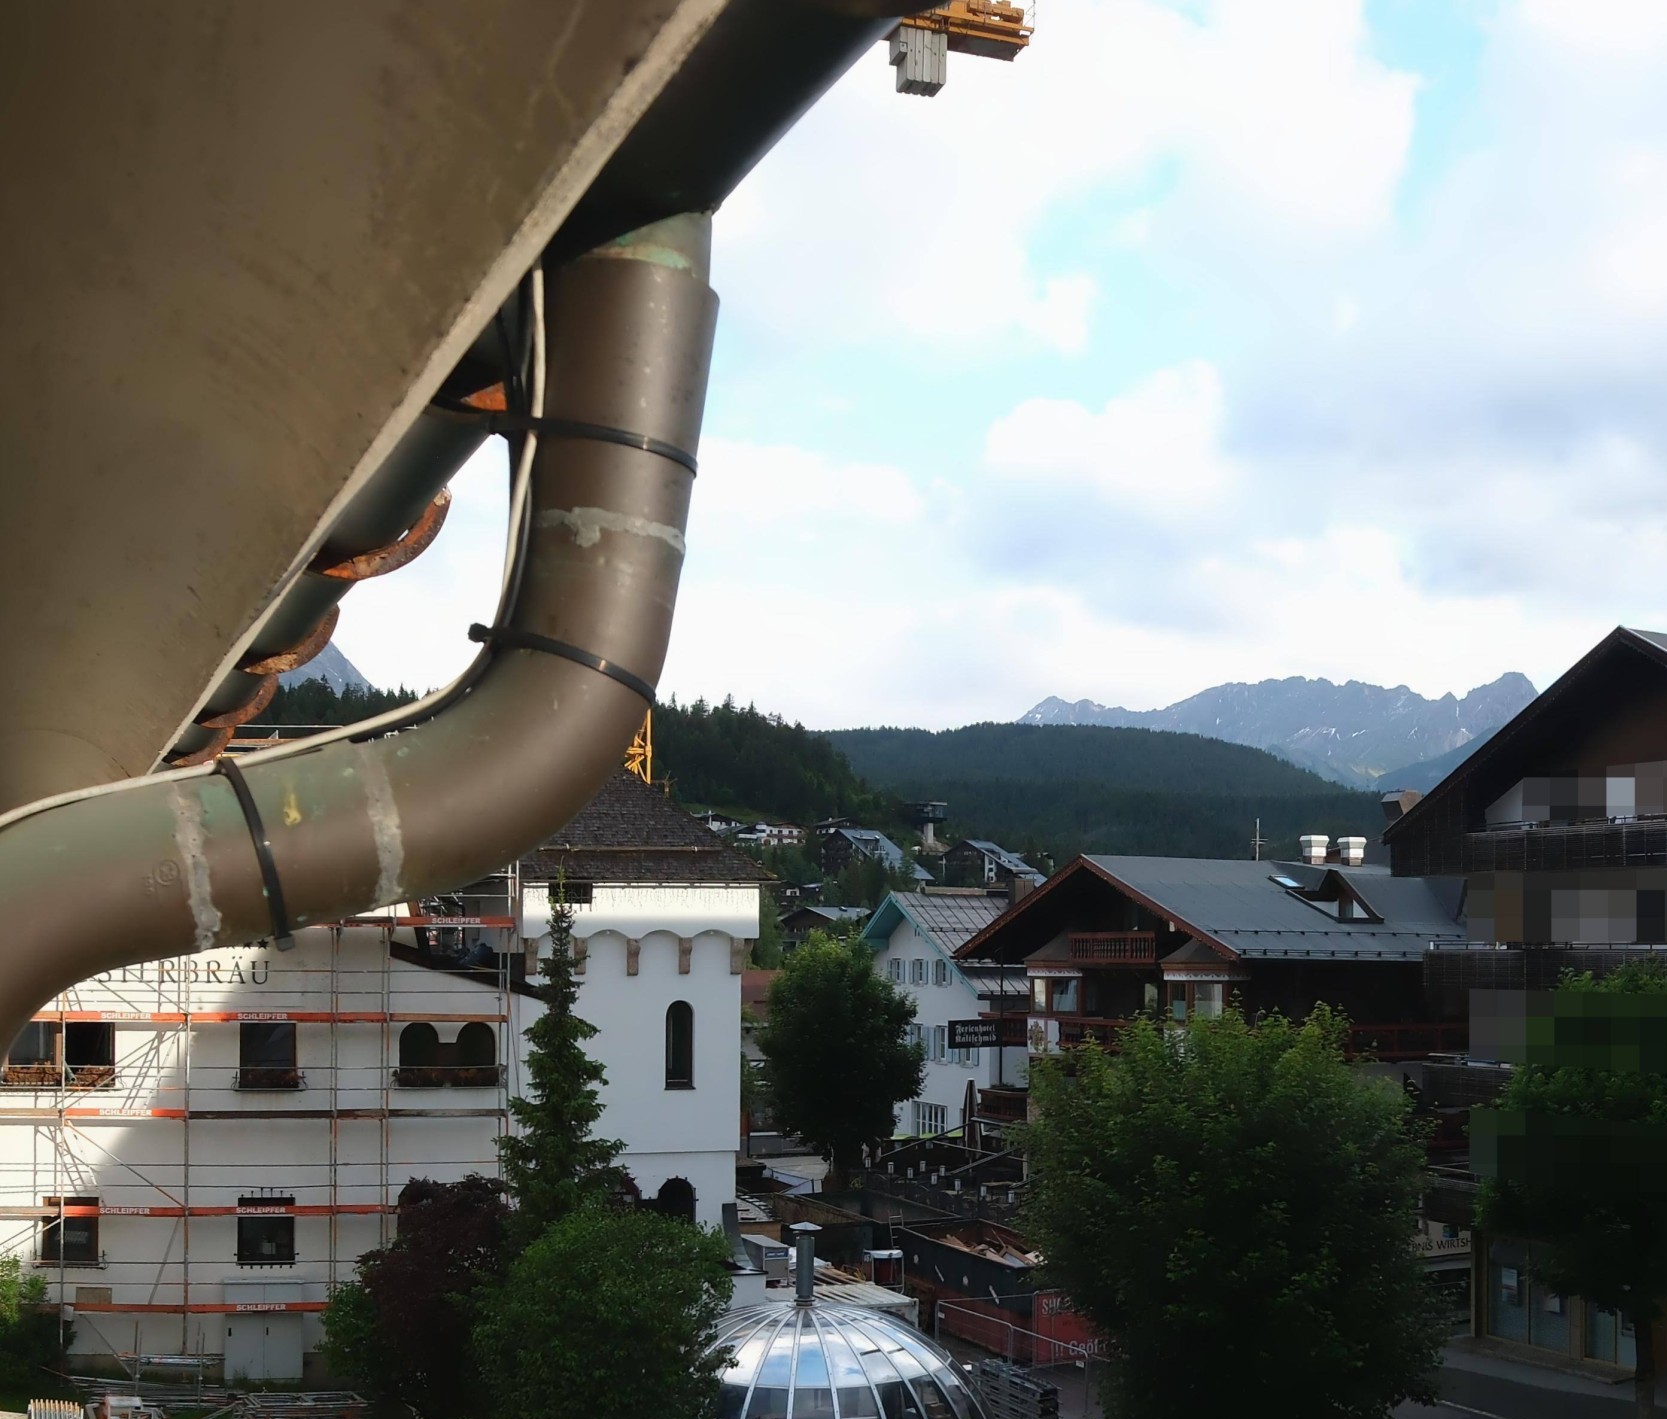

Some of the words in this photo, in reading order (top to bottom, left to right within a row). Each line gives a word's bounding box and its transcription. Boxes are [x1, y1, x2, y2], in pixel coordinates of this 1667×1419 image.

[431, 917, 481, 925] SCHLEIPFER
[100, 1012, 151, 1020] SCHLEIPFER
[237, 1012, 288, 1020] SCHLEIPFER
[99, 1207, 150, 1215] SCHLEIPFER
[236, 1206, 286, 1214] SCHLEIPFER
[236, 1303, 286, 1312] SCHLEIPFER
